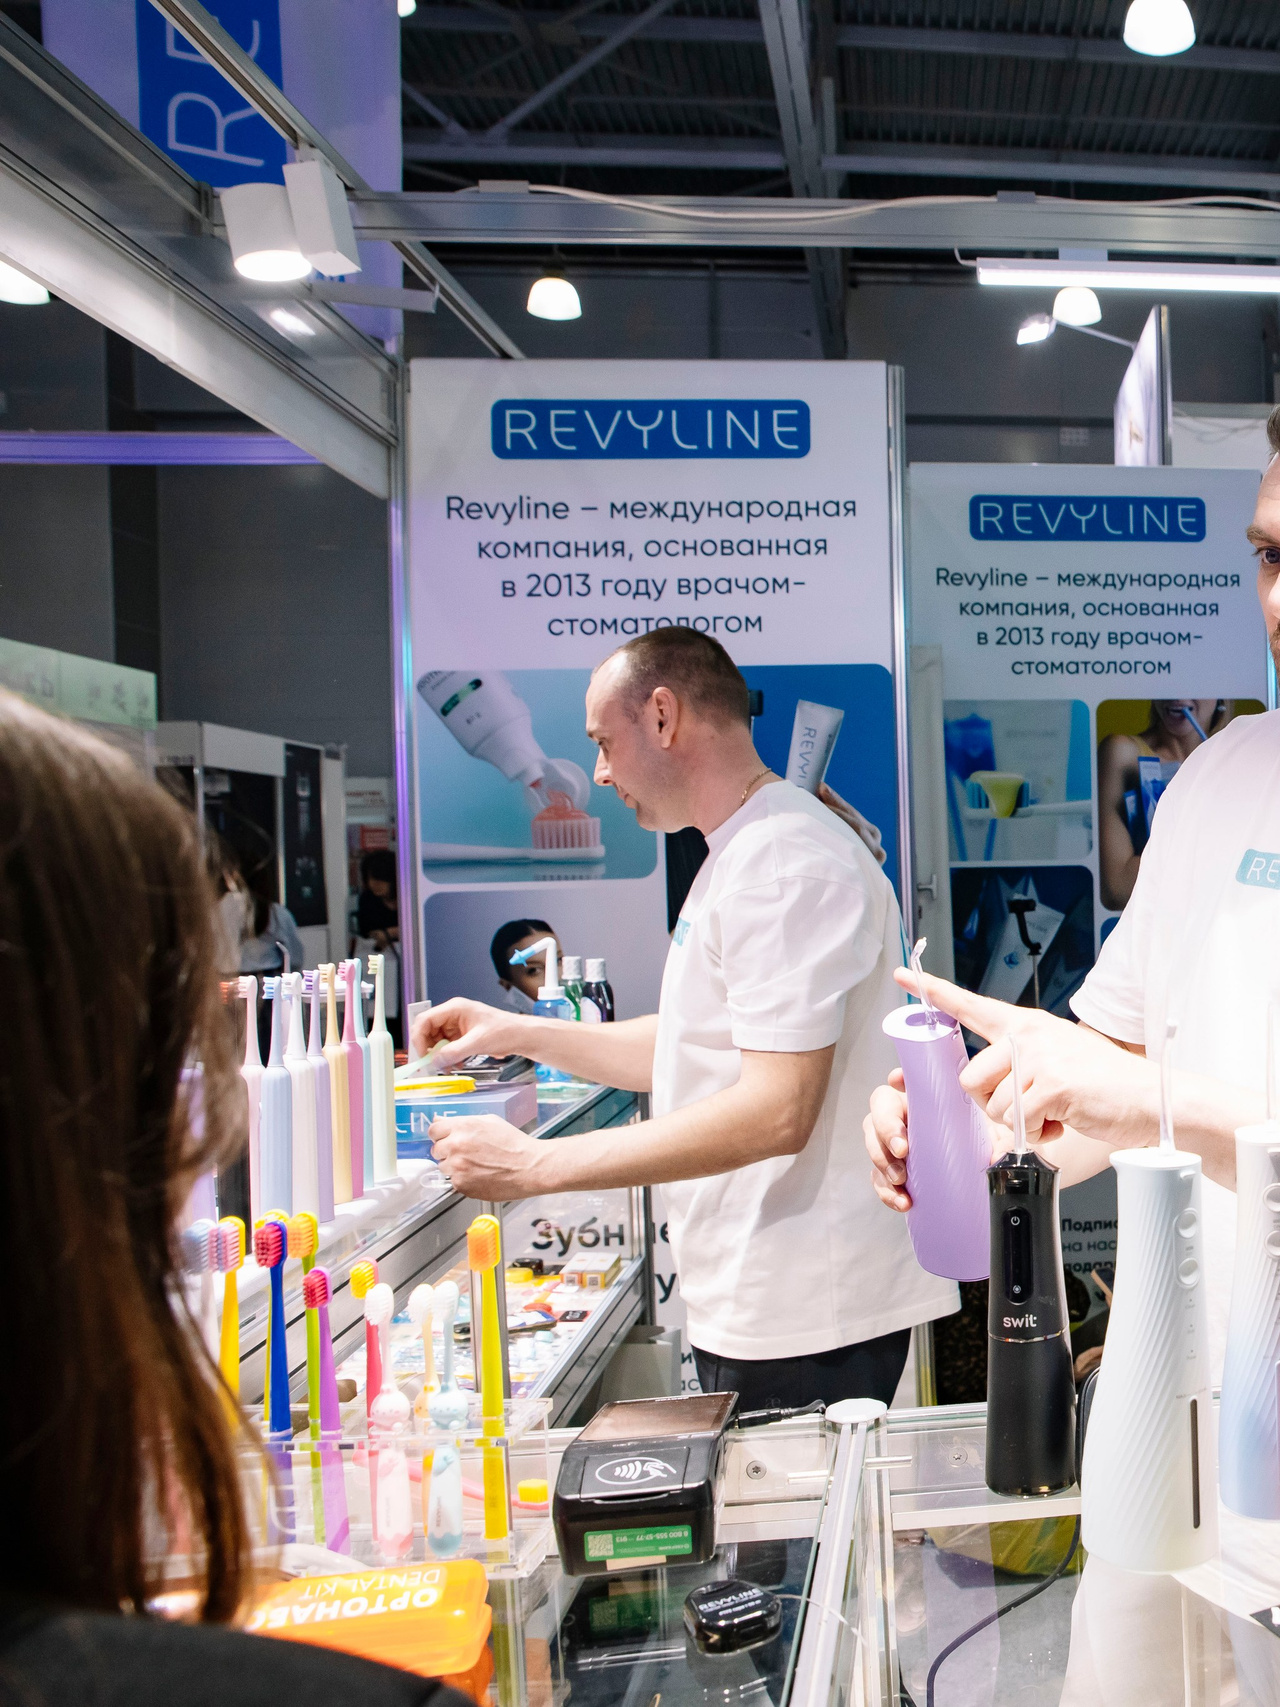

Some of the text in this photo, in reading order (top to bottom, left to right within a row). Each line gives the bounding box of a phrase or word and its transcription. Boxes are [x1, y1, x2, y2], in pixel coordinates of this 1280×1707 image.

[504, 409, 800, 450] REVYLINE
[446, 496, 570, 526] Revyline
[609, 498, 858, 524] международная
[979, 502, 1198, 535] REVYLINE
[477, 537, 828, 562] компания, основанная
[501, 573, 805, 602] в 2013 году врачом-
[935, 567, 1028, 591] Revyline
[1056, 572, 1241, 592] международная
[958, 601, 1220, 620] компания, основанная
[976, 627, 1203, 650] в 2013 году врачом-
[1010, 659, 1172, 676] стоматологом
[1003, 1313, 1038, 1328] swit
[299, 1568, 441, 1600] DENTAL KIT
[698, 1587, 763, 1612] REVYLINE
